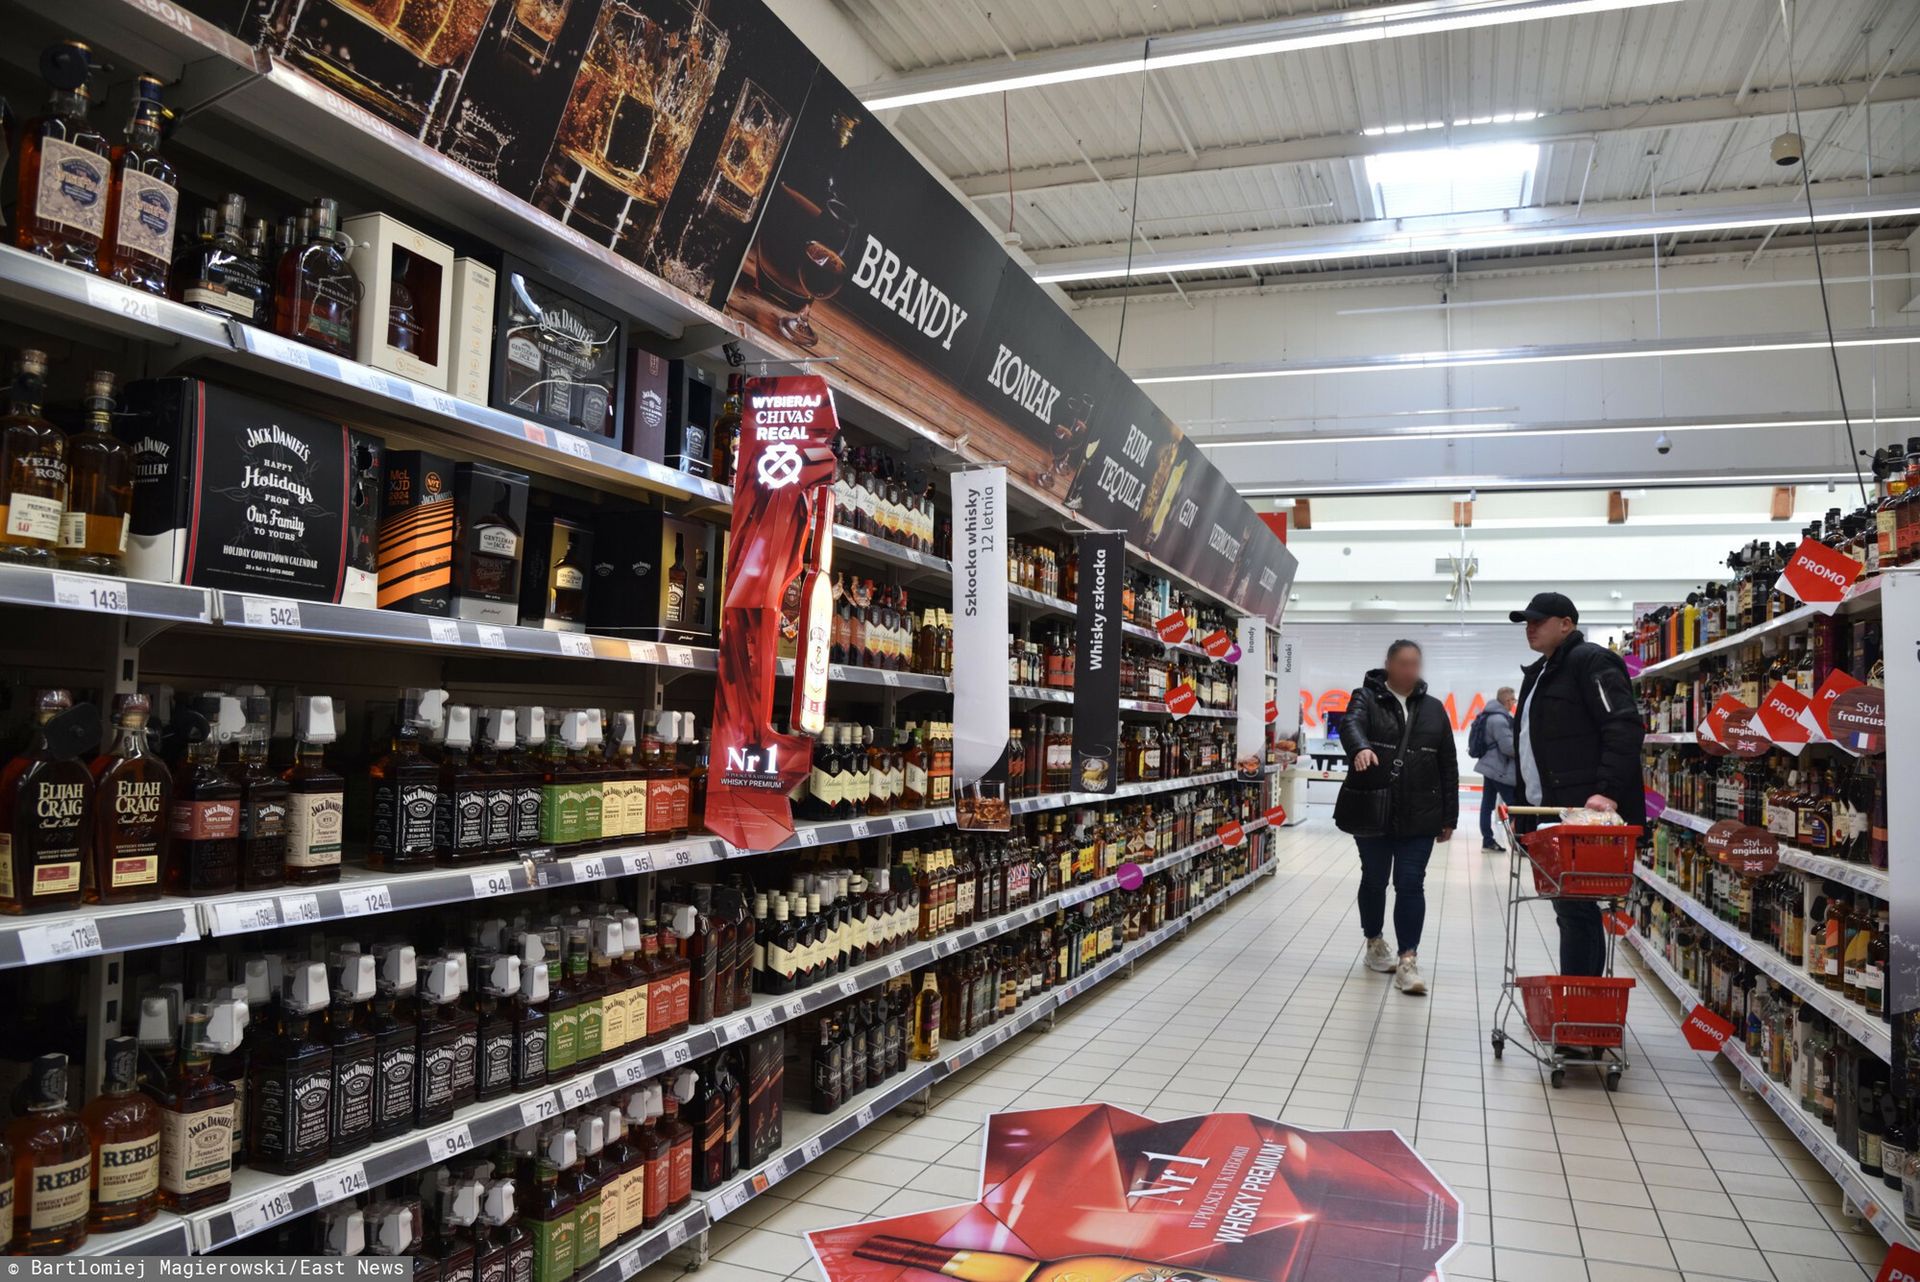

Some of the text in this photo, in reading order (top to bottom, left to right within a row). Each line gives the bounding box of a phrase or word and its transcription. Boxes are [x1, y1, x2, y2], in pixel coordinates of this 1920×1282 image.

[852, 234, 967, 350] BRANDY
[122, 297, 149, 320] 224
[540, 308, 562, 332] JACK
[511, 342, 540, 359] GENTLEMAN
[518, 352, 532, 362] JACK
[987, 344, 1061, 424] KONIAK
[752, 394, 822, 408] WYBIERAJ
[756, 410, 814, 424] CHIVAS
[756, 426, 810, 440] REGAL
[144, 436, 170, 458] DANIEL
[247, 425, 312, 464] JACK DANIEL'S
[1122, 424, 1152, 468] RUM
[18, 456, 68, 472] YELLO
[136, 463, 168, 476] TILLERY
[264, 458, 294, 472] HAPPY
[241, 466, 314, 504] Holidays
[1097, 456, 1146, 512] TEQUILA
[264, 494, 290, 506] FROM
[246, 505, 306, 538] Our Family
[981, 486, 994, 552] 12 letnia
[1179, 499, 1198, 528] GIN
[254, 527, 296, 542] TO YOURS
[484, 534, 514, 545] GENTLEMAN
[222, 544, 318, 569] HOLIDAY COUNTDOWN CALENDAR
[965, 488, 980, 616] Szkocka whisky
[1797, 556, 1846, 586] PROMO
[90, 589, 118, 612] 143
[270, 607, 292, 626] 542
[1090, 549, 1107, 670] Whisky szkocka
[1162, 620, 1184, 635] PROMO
[1207, 637, 1227, 650] PROMO
[1169, 691, 1192, 710] PROMO
[1856, 702, 1880, 716] Styl
[726, 744, 778, 774] Nr 1
[116, 780, 161, 800] ELIJAH
[720, 778, 748, 786] WHISKY
[38, 782, 84, 800] ELIJAH
[37, 799, 82, 818] CRAIG
[116, 796, 160, 814] CRAIG
[402, 794, 418, 806] JACK
[311, 802, 326, 817] JACK
[806, 834, 816, 845] 61
[1220, 828, 1240, 841] PROMO
[1744, 838, 1760, 848] Styl
[676, 851, 690, 865] 99
[1732, 846, 1772, 857] angielski
[586, 864, 600, 878] 94
[634, 858, 648, 872] 95
[488, 878, 506, 894] 94
[365, 894, 385, 912] 124
[71, 928, 90, 948] 173
[1690, 1016, 1724, 1040] PROMO
[426, 1053, 439, 1068] JACK
[674, 1048, 688, 1063] 99
[382, 1058, 397, 1072] JACK
[627, 1066, 642, 1081] 95
[340, 1070, 356, 1086] JACK
[294, 1084, 311, 1100] JACK
[576, 1086, 592, 1102] 94
[536, 1101, 554, 1118] 72
[188, 1121, 208, 1139] JACK
[446, 1134, 466, 1154] 94
[810, 1145, 820, 1157] 61
[1142, 1151, 1210, 1168] 1
[36, 1163, 91, 1192] REBE
[340, 1173, 360, 1194] 124
[1127, 1168, 1198, 1206] Nr
[1188, 1146, 1250, 1229] W POLSCE W KATEGORII
[1213, 1194, 1264, 1244] WHISKY
